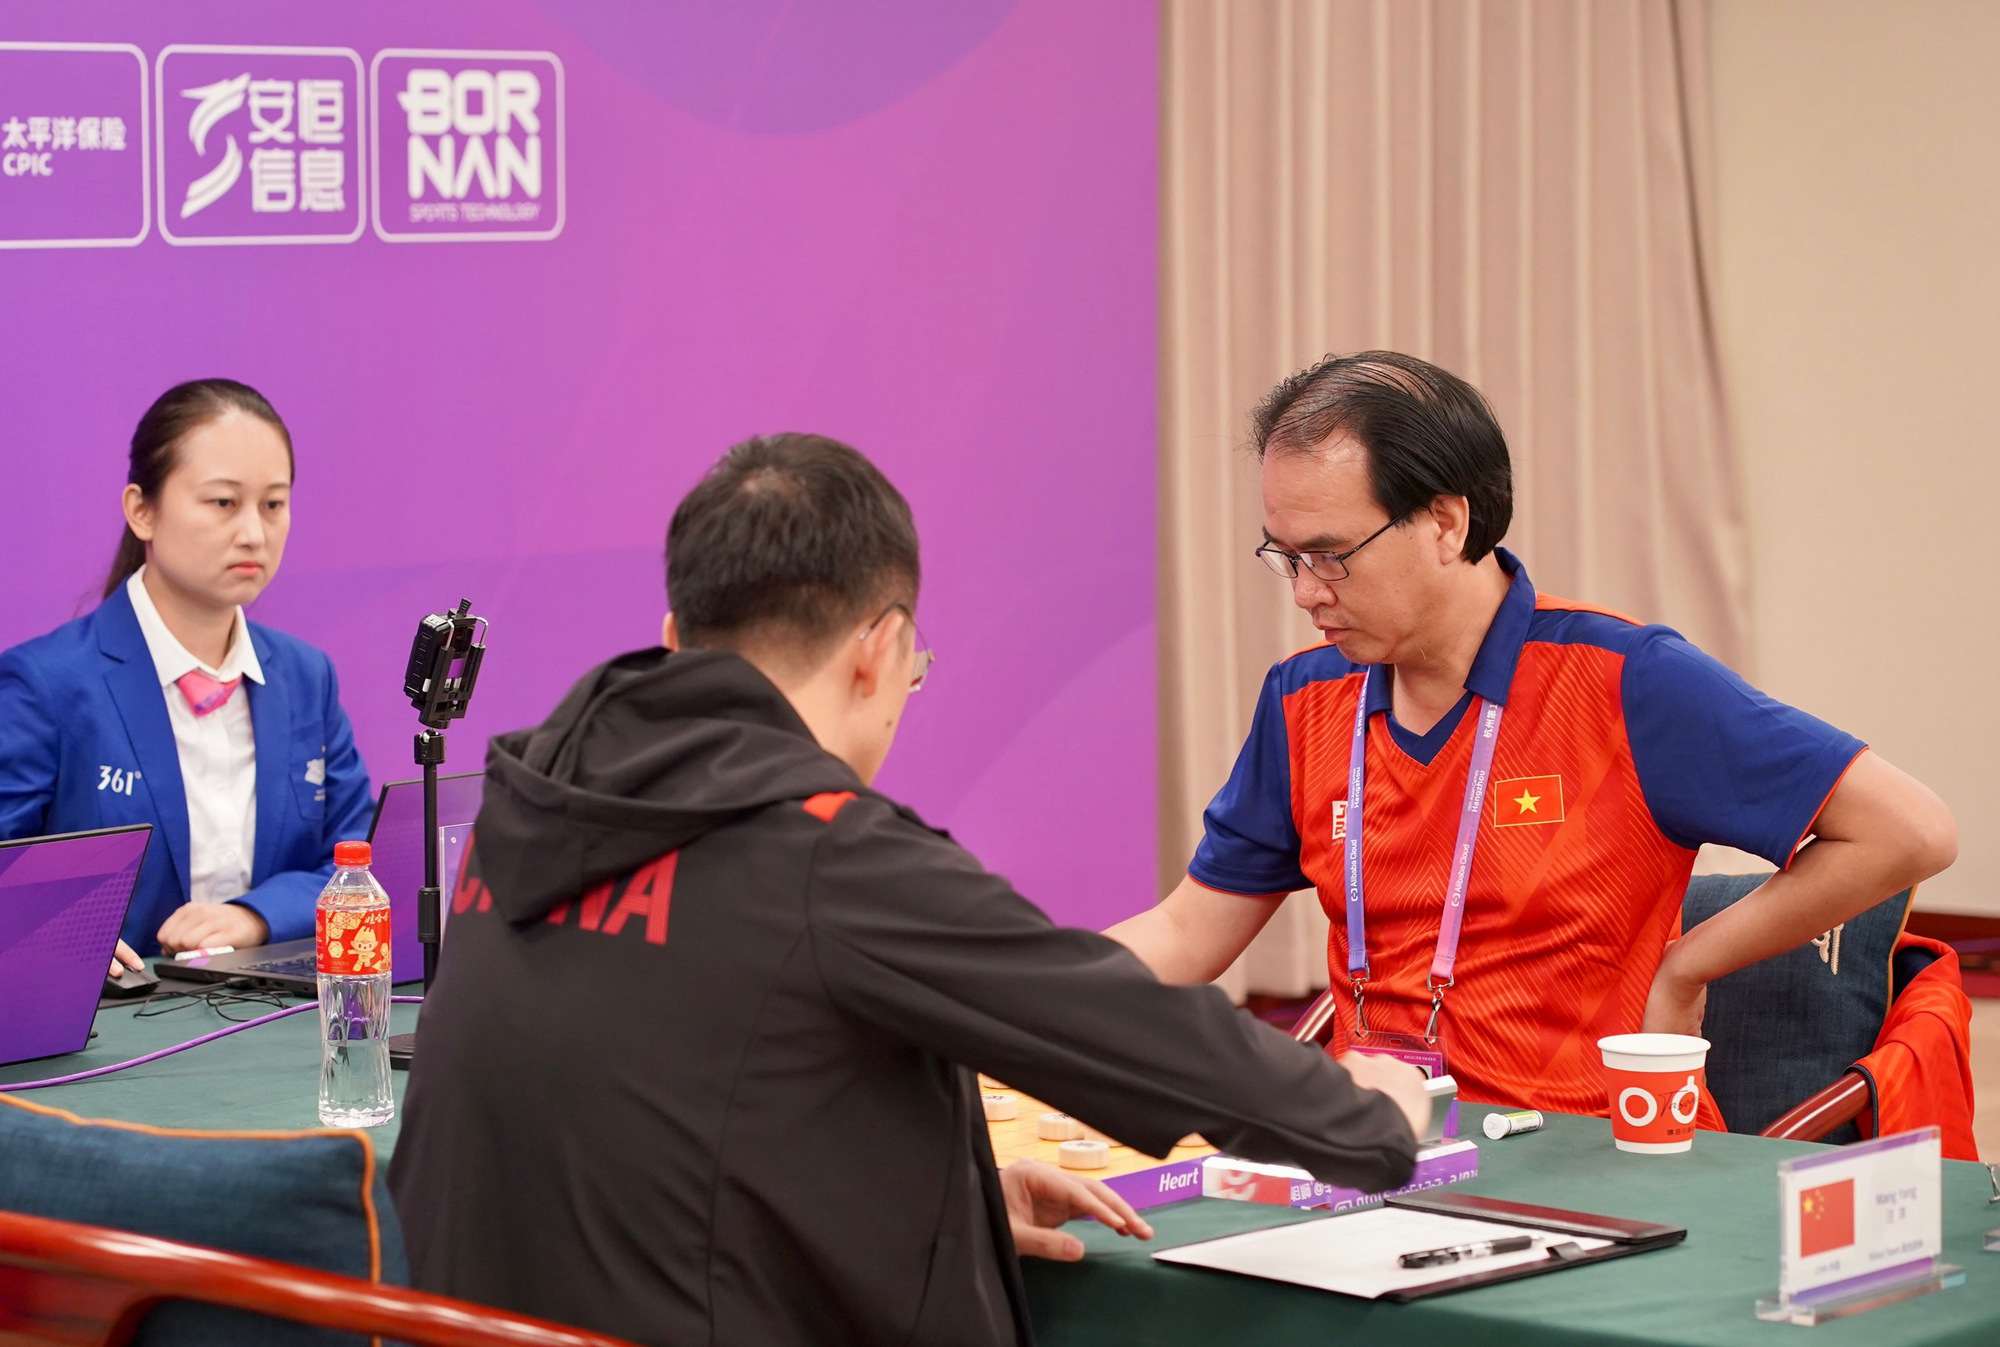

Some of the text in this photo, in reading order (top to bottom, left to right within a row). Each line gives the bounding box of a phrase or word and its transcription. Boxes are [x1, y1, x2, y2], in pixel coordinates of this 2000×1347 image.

[248, 78, 346, 144] 安恒
[396, 69, 541, 135] BOR
[2, 116, 127, 151] 太平洋保险
[2, 152, 54, 177] CPIC
[249, 147, 346, 213] 信息
[407, 134, 542, 200] NAN
[97, 765, 142, 796] 361°
[1353, 767, 1361, 809] Hangzhou
[1472, 770, 1486, 813] Hangzhou
[1350, 839, 1358, 887] Alibaba Cloud
[1454, 843, 1470, 893] Alibaba Cloud
[1159, 1167, 1199, 1193] Heart
